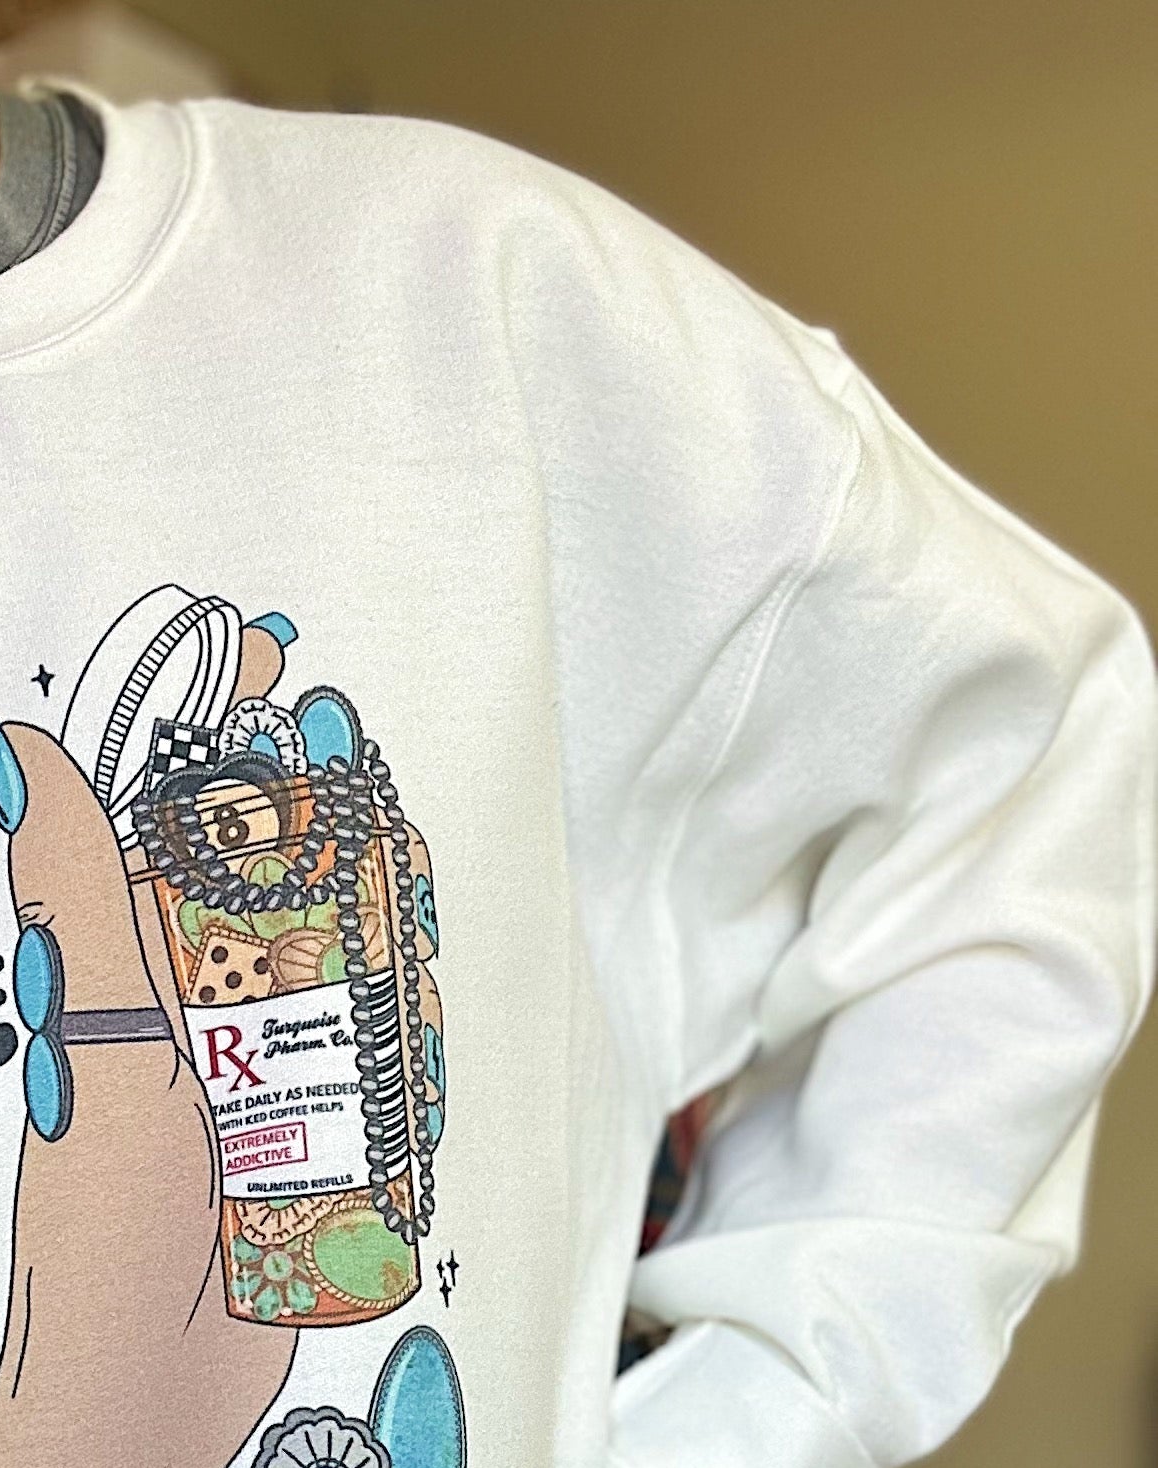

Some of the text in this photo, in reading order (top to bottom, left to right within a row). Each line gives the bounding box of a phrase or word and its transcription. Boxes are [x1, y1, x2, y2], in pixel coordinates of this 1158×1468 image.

[214, 803, 250, 849] 8
[261, 1012, 341, 1039] Turquoise
[263, 1029, 354, 1059] Pharm. Co.
[212, 1082, 359, 1117] TAKE DAILY AS NEEDED
[218, 1118, 243, 1132] WITH
[270, 1104, 309, 1121] COFFEE
[311, 1101, 344, 1114] HELPS
[224, 1128, 298, 1155] EXTREMELY
[226, 1146, 293, 1171] ADDICTIVE
[247, 1174, 354, 1193] UNLIMITED REFILLS
